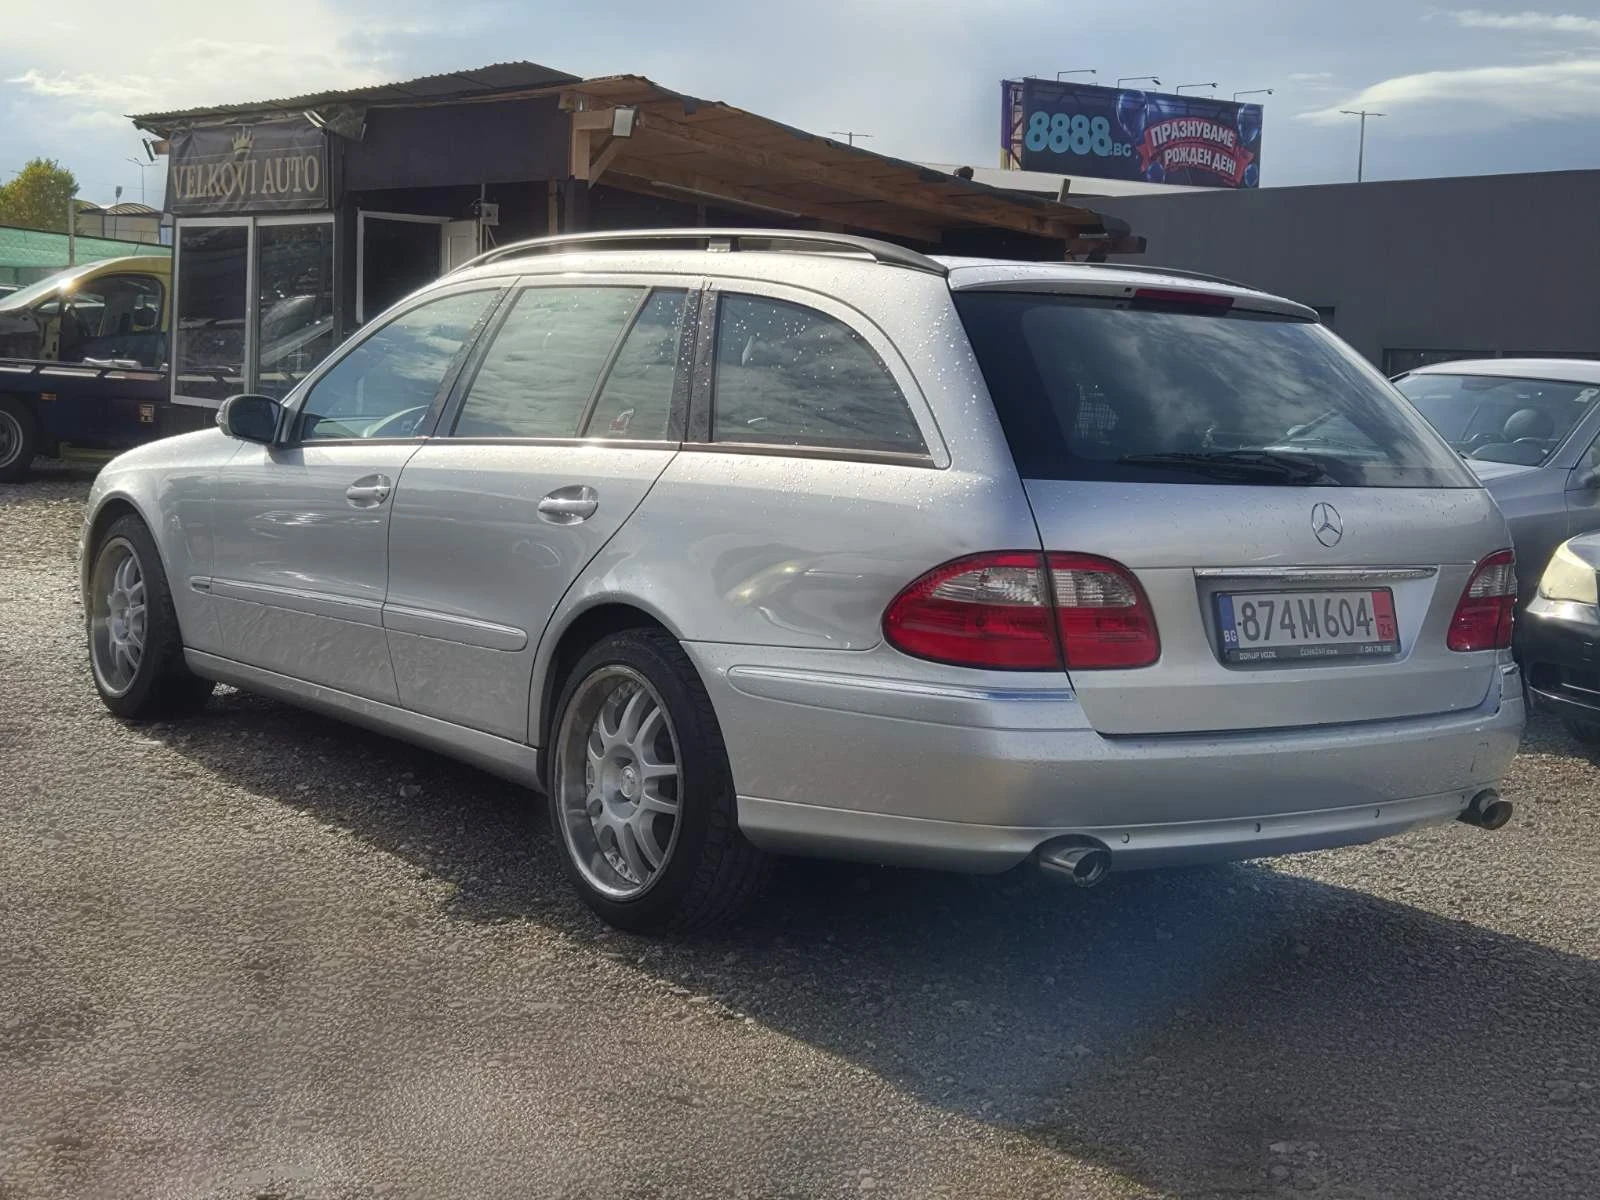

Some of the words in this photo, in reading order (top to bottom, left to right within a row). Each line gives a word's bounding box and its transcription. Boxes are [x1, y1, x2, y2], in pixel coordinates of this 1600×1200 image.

[1150, 120, 1234, 147] ПРАЗНУВАМЕ
[1164, 147, 1212, 166] РОЖДЕН
[1212, 153, 1237, 176] ДЕН!
[172, 159, 257, 199] VELKOVI
[261, 155, 320, 194] AUTO
[1241, 597, 1371, 641] 874M604
[1224, 630, 1237, 642] BG
